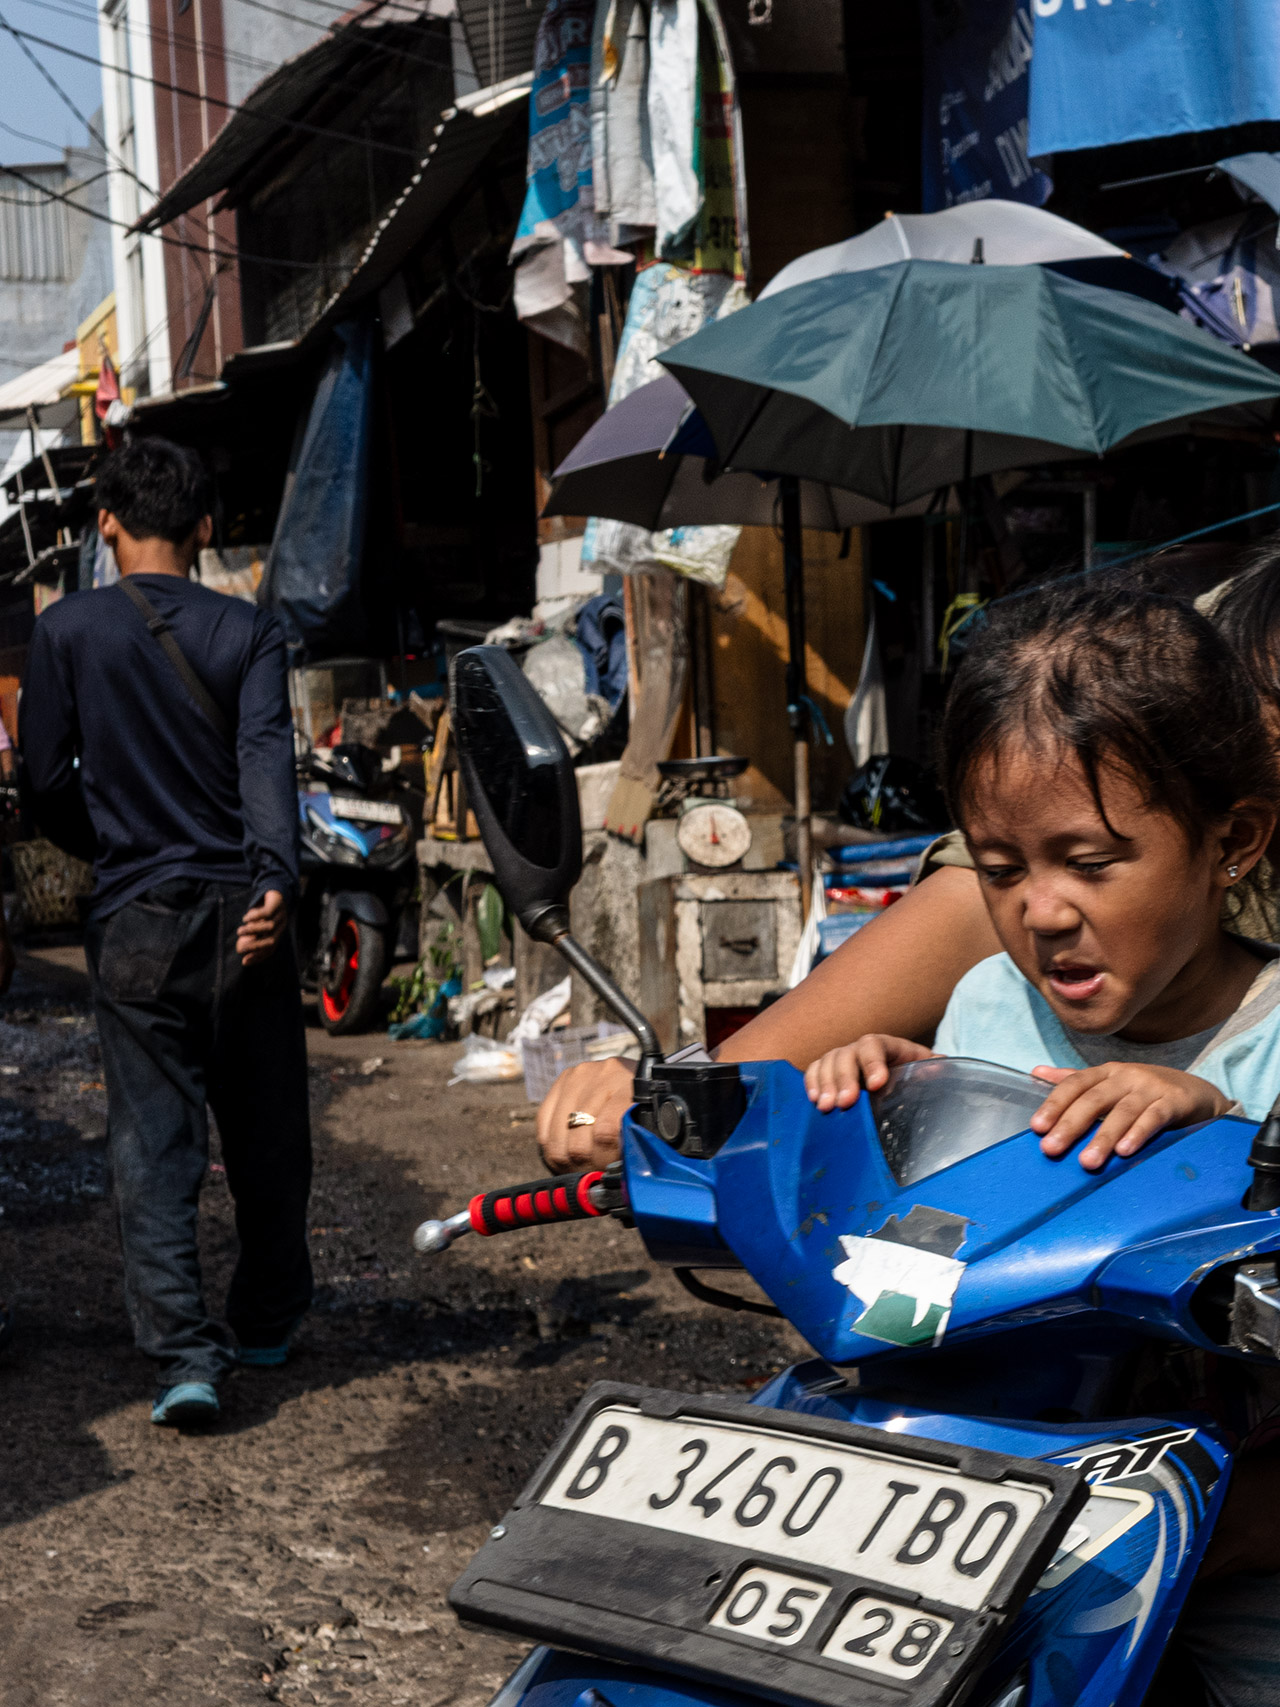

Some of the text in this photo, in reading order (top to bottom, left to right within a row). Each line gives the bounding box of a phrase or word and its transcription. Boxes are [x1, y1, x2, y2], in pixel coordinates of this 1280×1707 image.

[565, 1424, 630, 1500] B
[648, 1438, 843, 1538] 3460
[1062, 1427, 1199, 1487] AT
[724, 1579, 940, 1667] 05 28
